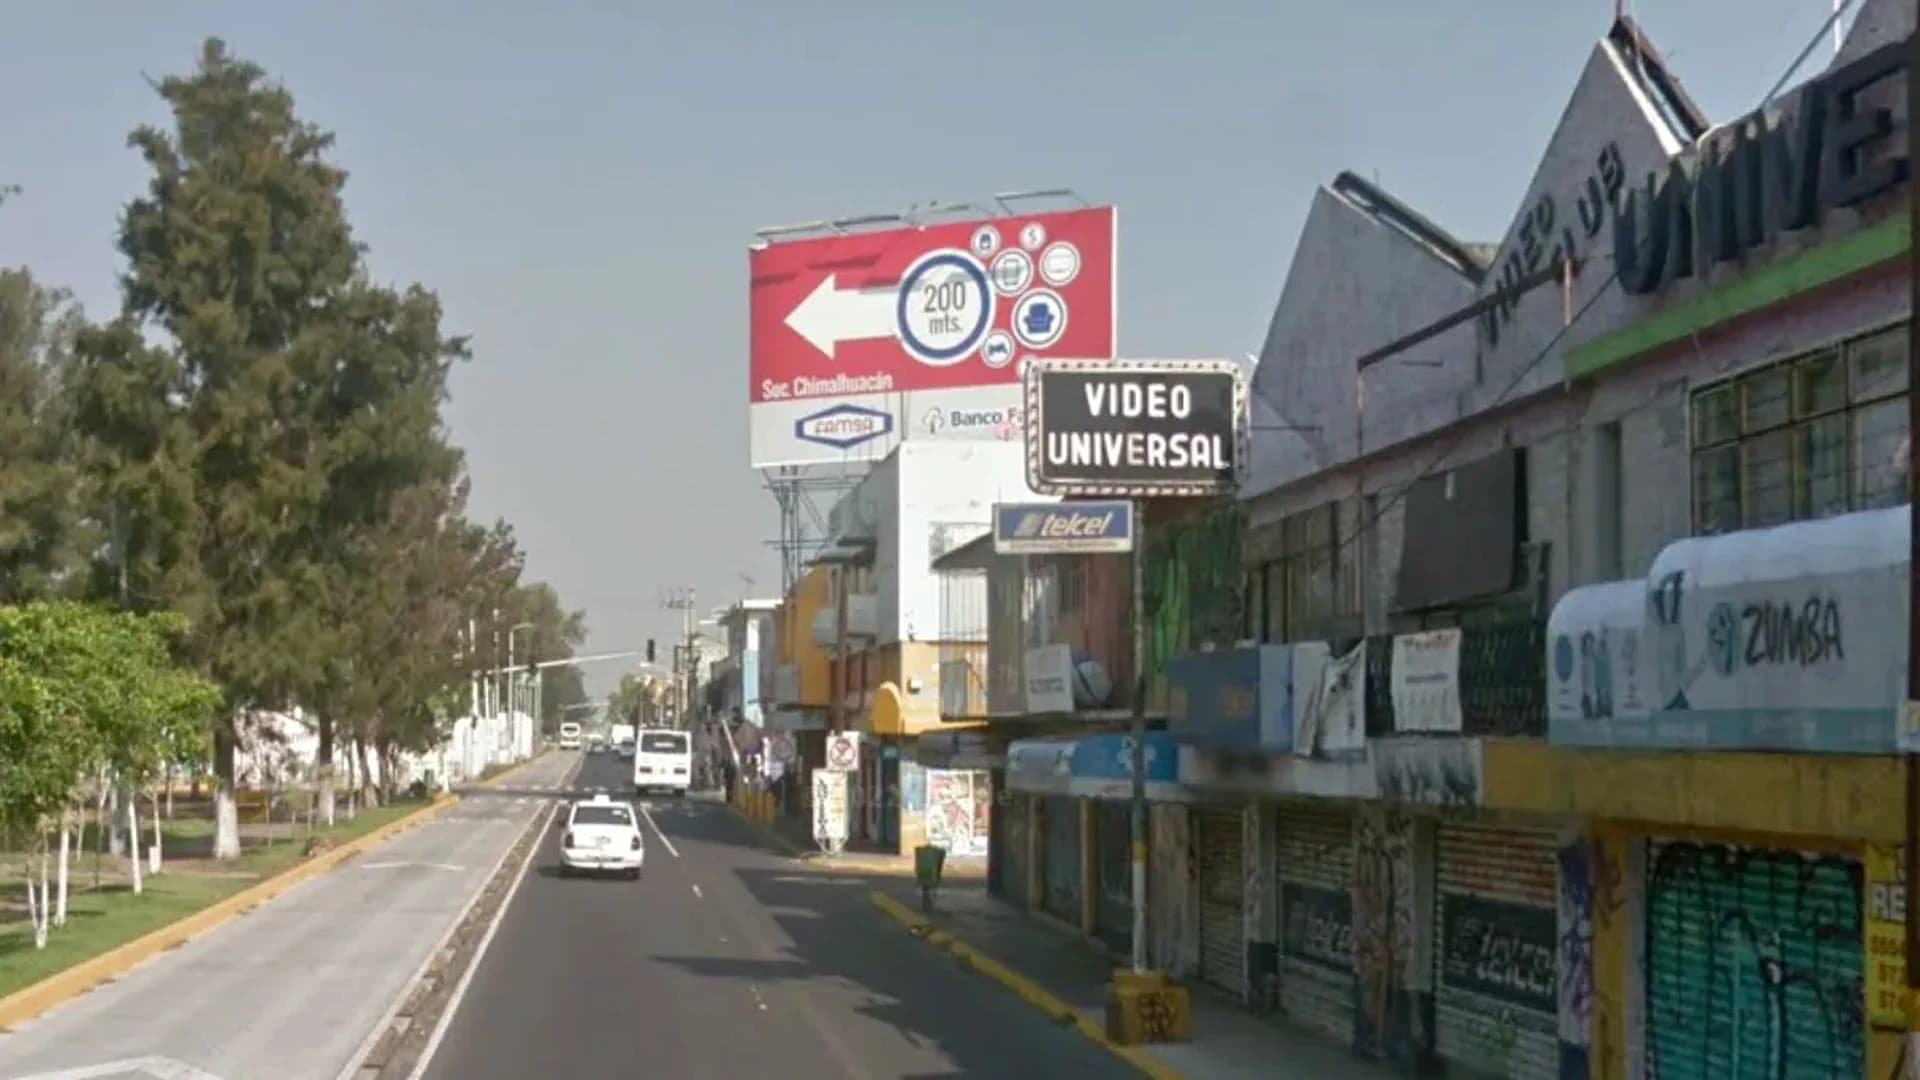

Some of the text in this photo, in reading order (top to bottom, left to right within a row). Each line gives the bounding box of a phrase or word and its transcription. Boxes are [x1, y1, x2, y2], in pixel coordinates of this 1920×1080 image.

[924, 281, 966, 313] 200
[929, 315, 963, 334] mts.
[762, 371, 893, 399] Suc. Chimalhuacán
[1084, 382, 1192, 418] VIDEO
[951, 410, 1001, 426] Banco
[1048, 433, 1231, 469] UNIVERSAL
[1040, 510, 1114, 537] telcel
[1742, 598, 1844, 667] ZUMBA
